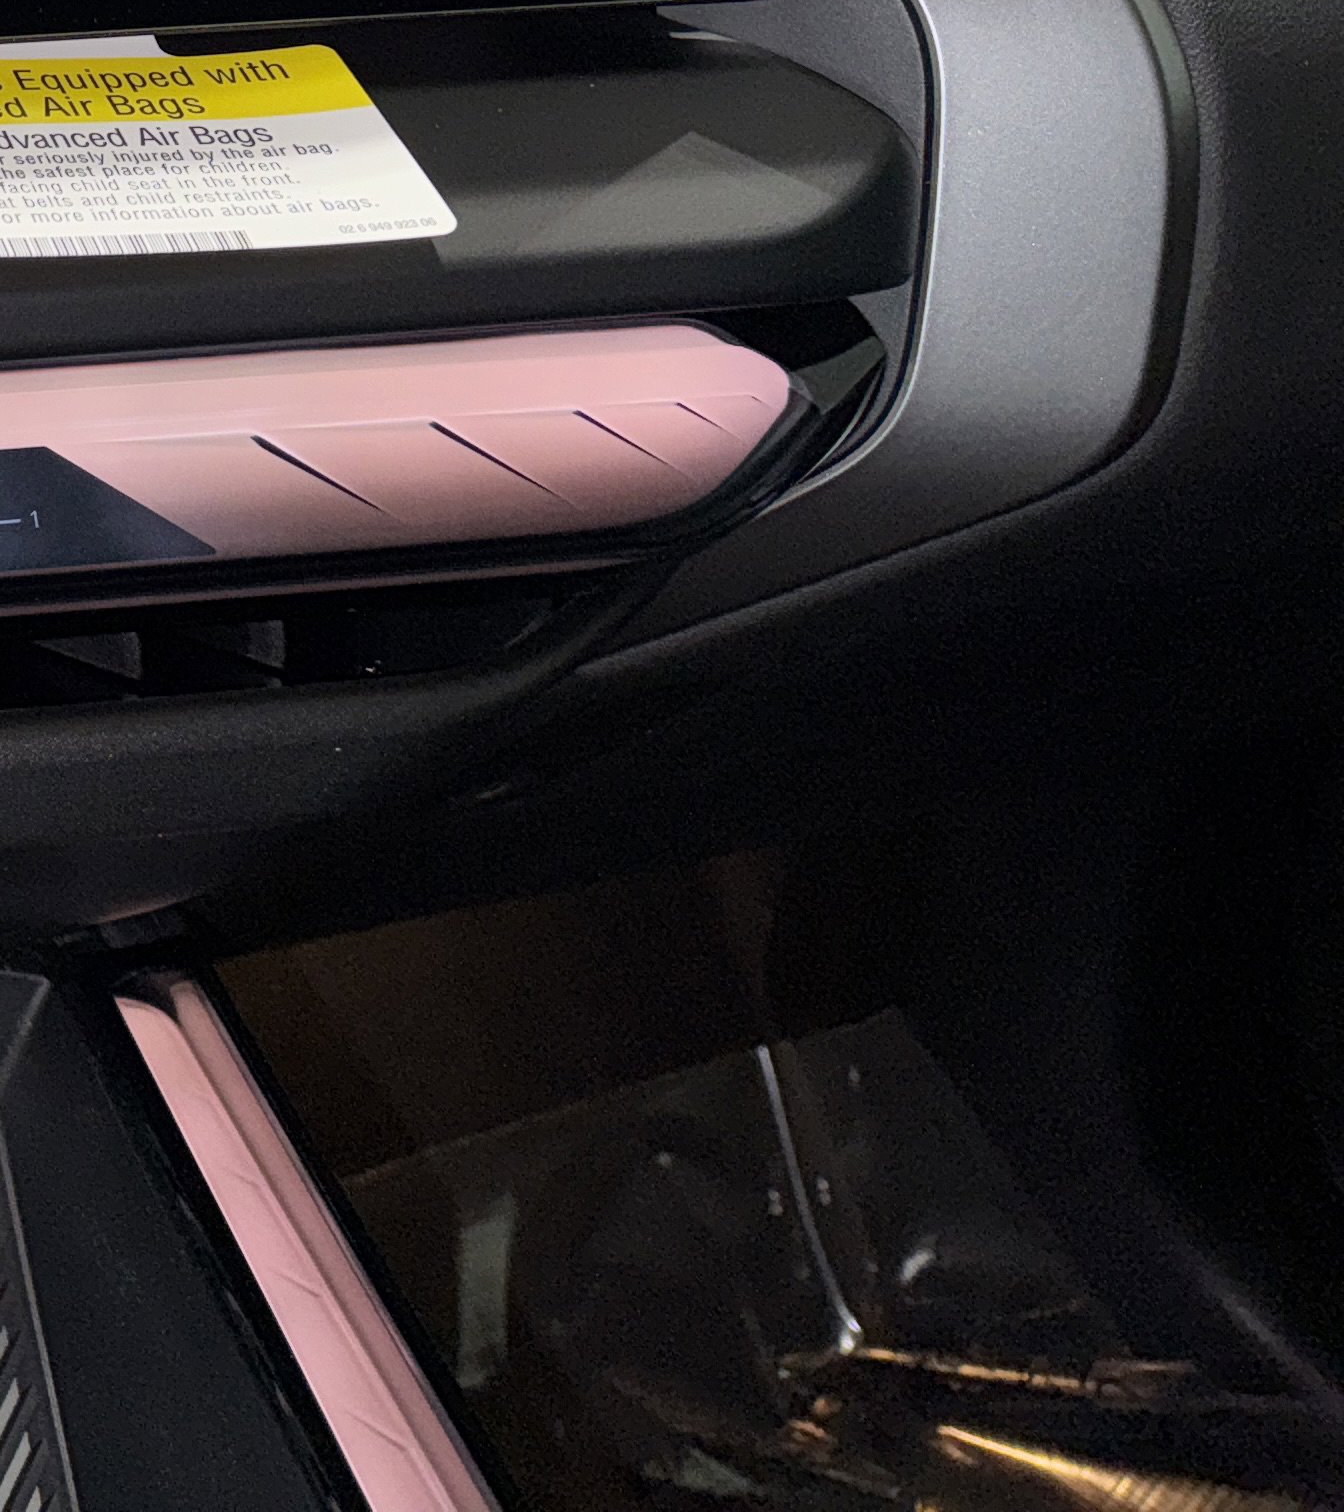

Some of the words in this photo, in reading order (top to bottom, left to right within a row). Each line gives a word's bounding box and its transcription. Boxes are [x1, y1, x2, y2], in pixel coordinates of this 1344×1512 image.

[12, 65, 196, 95] Equipped
[203, 59, 291, 85] with
[43, 95, 94, 118] Air
[105, 93, 206, 120] Bags
[139, 126, 181, 148] Air
[188, 124, 275, 148] Bags
[14, 151, 106, 167] seriously
[112, 148, 185, 165] injured
[191, 148, 215, 165] by
[220, 146, 256, 160] the
[261, 144, 288, 158] air
[292, 142, 340, 157] bag.
[33, 165, 95, 179] safest
[101, 163, 156, 180] place
[161, 162, 191, 176] for
[198, 159, 290, 175] children.
[70, 178, 121, 192] child
[127, 177, 171, 191] seat
[177, 175, 197, 189] in
[200, 174, 237, 188] the
[240, 171, 302, 186] front.
[23, 195, 74, 209] belts
[80, 193, 119, 207] and
[125, 191, 177, 206] child
[183, 188, 292, 204] restraints.
[31, 210, 86, 224] more
[91, 205, 214, 223] information
[220, 202, 283, 218] about
[288, 200, 314, 214] air
[318, 196, 381, 212] bags.
[29, 509, 41, 530] 1
